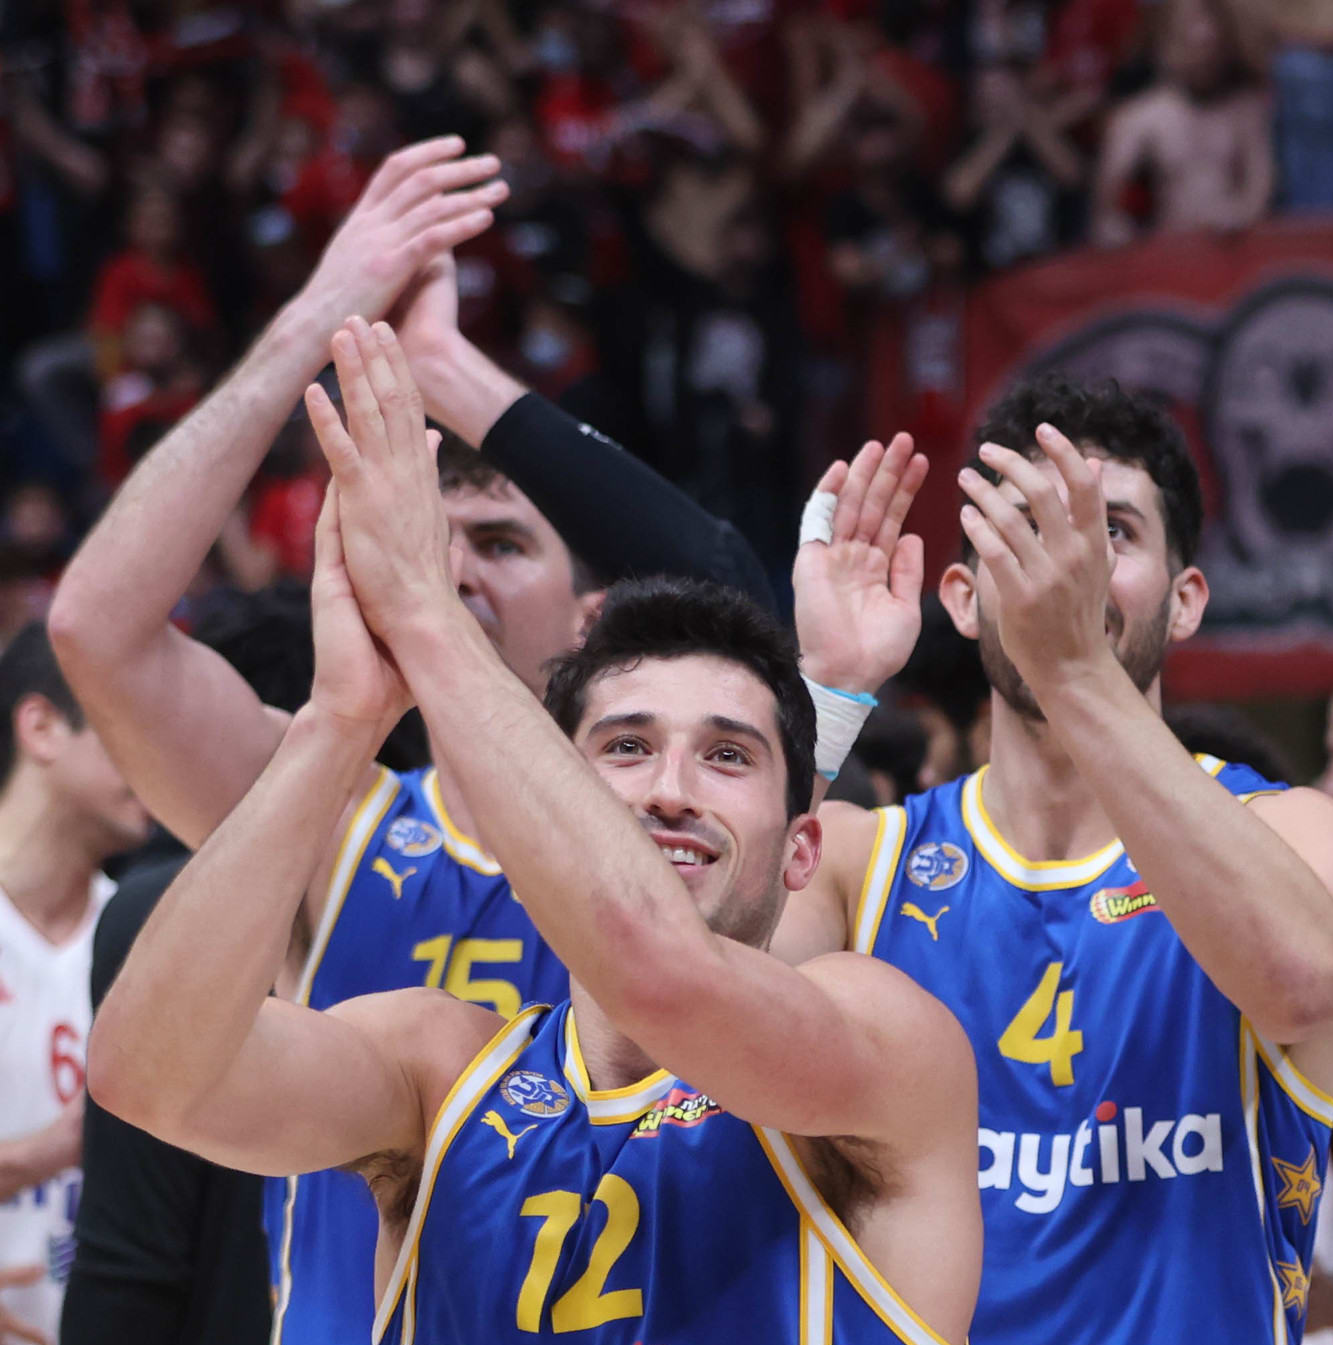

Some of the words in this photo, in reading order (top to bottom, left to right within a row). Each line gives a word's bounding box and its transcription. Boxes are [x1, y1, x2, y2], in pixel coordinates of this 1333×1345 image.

[1107, 893, 1157, 918] Winn
[53, 1024, 85, 1105] 6
[999, 963, 1083, 1087] 4
[978, 1101, 1223, 1215] aytika
[517, 1174, 643, 1334] 12
